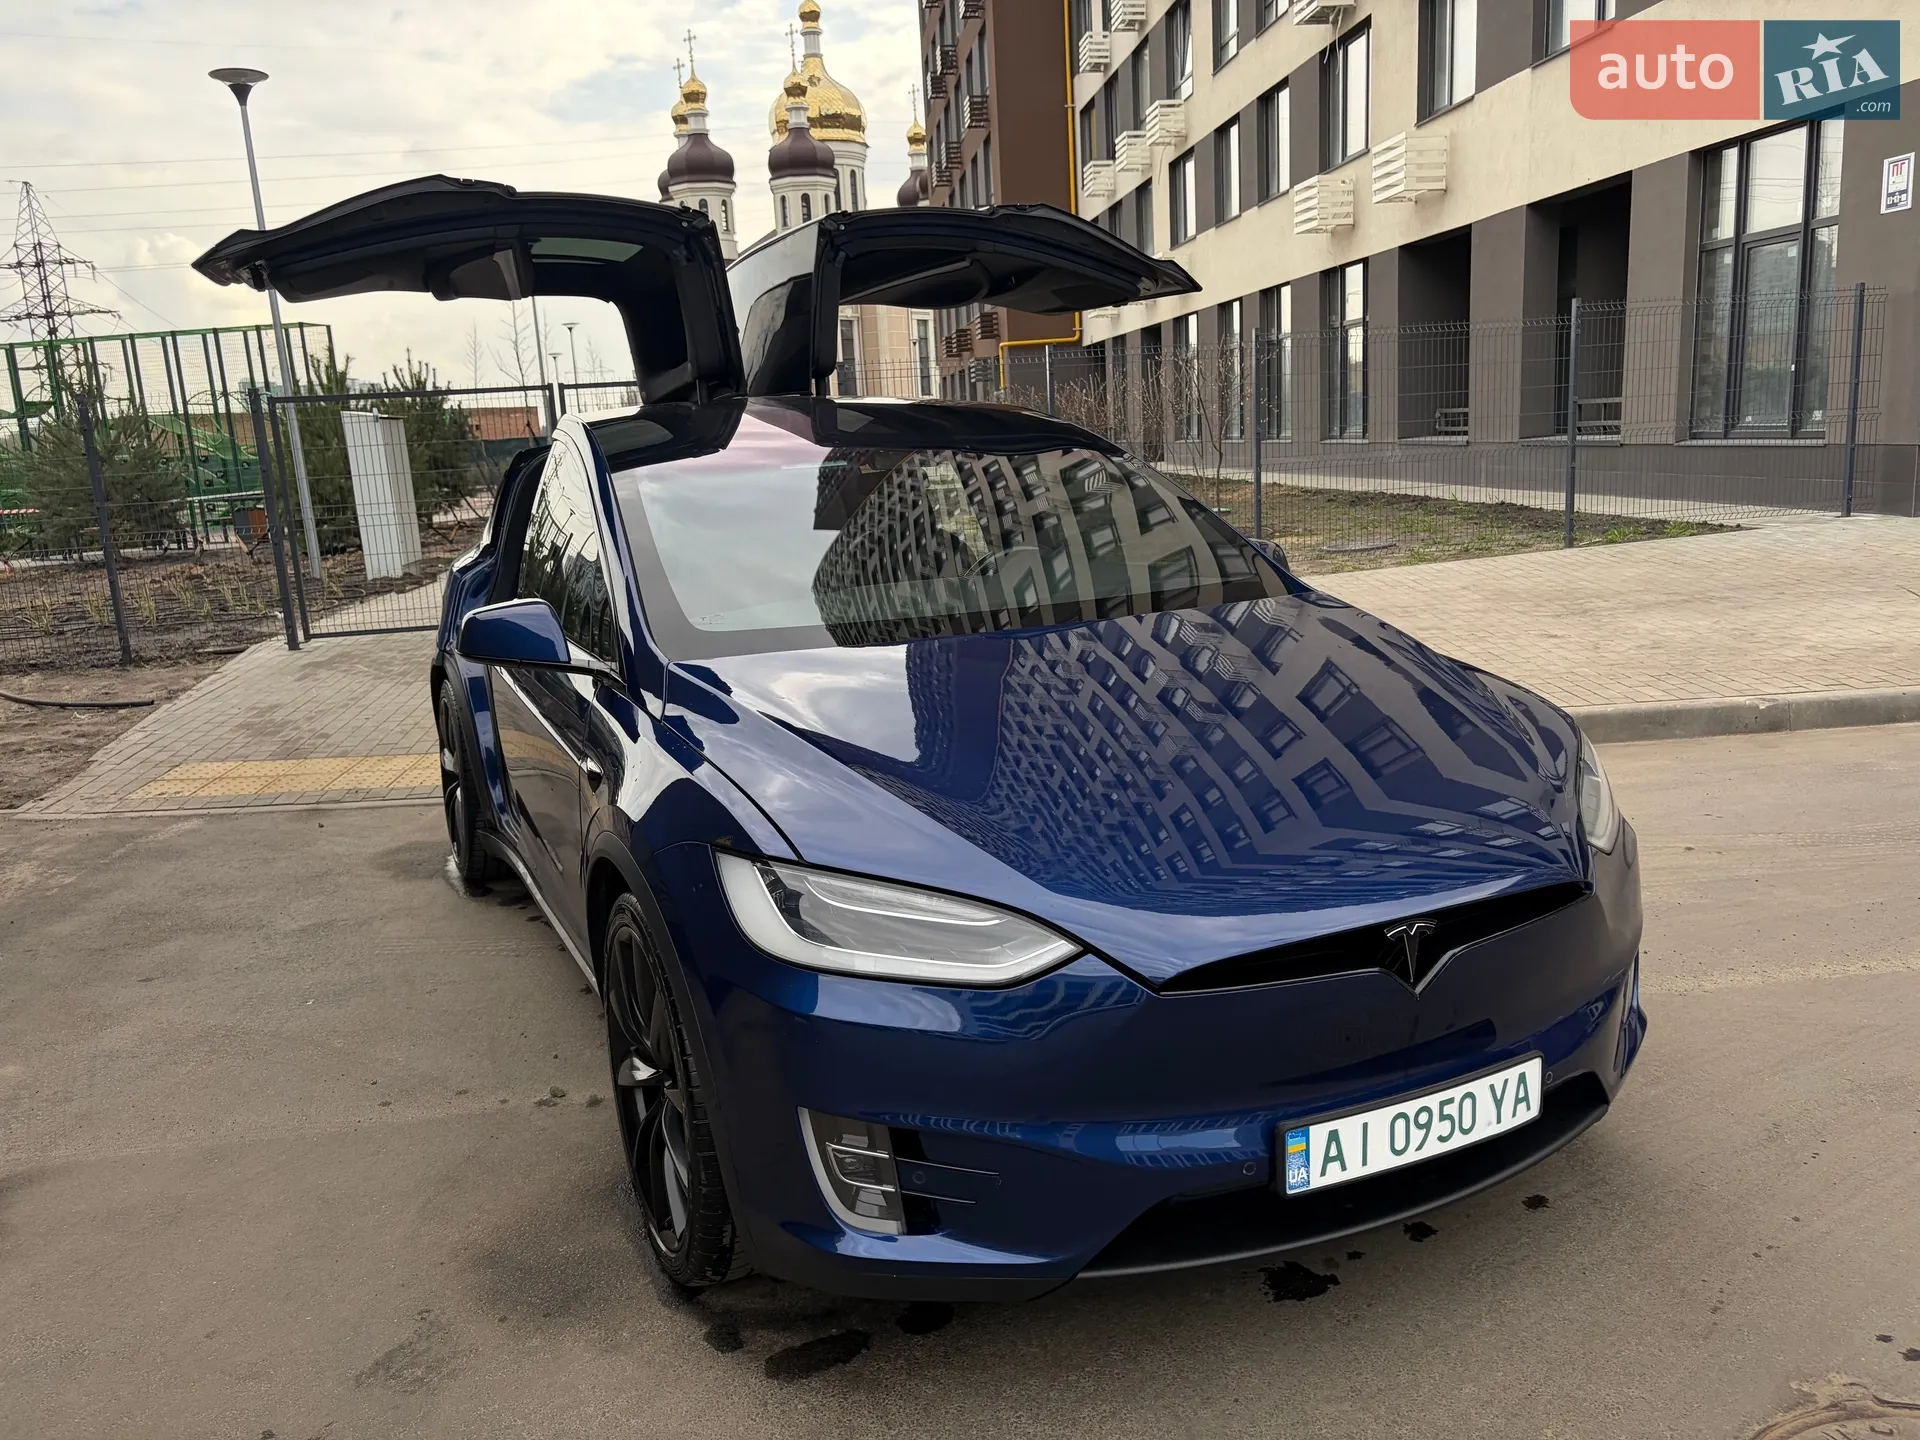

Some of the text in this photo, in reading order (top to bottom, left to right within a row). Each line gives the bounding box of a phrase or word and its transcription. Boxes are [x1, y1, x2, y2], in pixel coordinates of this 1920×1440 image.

[1319, 1071, 1531, 1178] AI 0950 YA
[1289, 1167, 1307, 1183] UA
